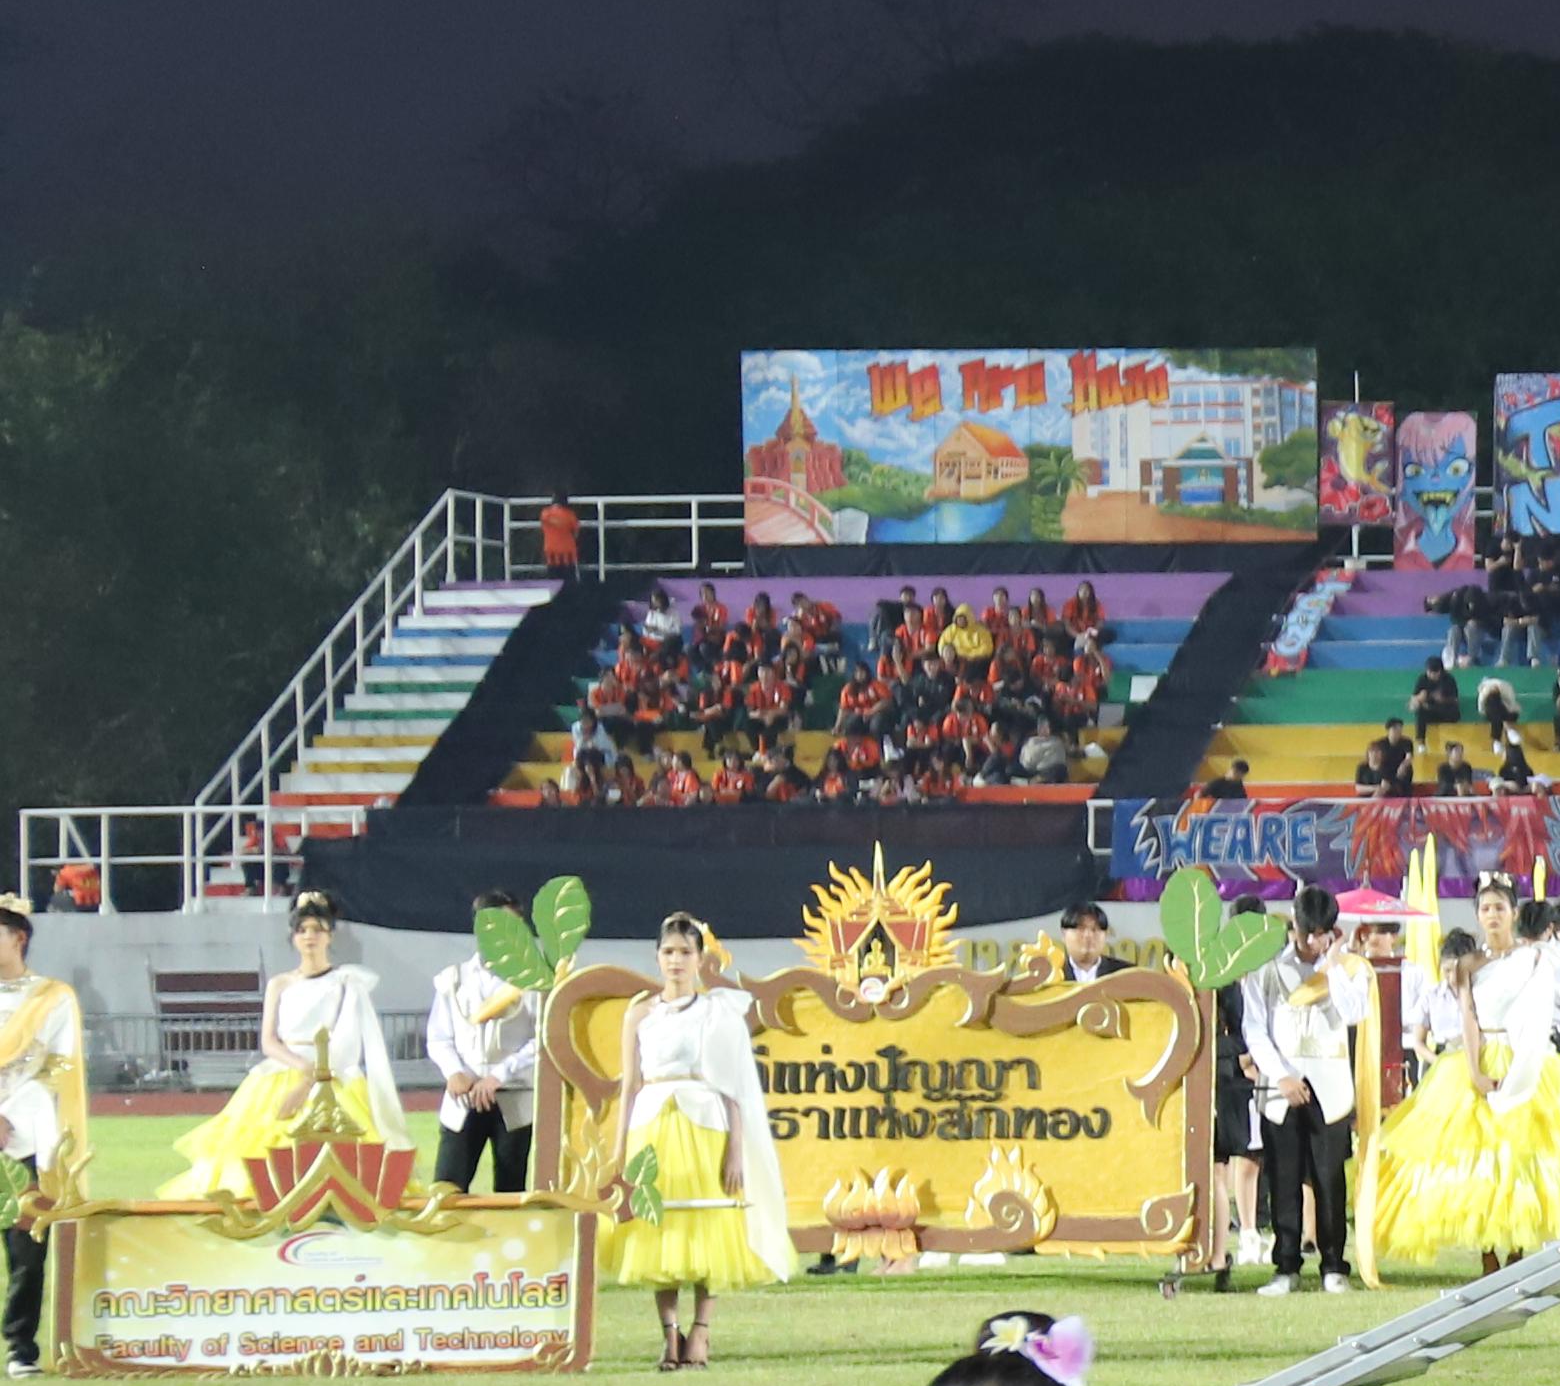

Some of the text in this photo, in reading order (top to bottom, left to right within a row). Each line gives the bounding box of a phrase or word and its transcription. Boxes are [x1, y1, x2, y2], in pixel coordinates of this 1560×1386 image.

[94, 1270, 570, 1319] คณะวิทยาศาสตร์และเทคโนโลยี
[94, 1333, 193, 1362] Faculty
[201, 1332, 231, 1356] of
[238, 1331, 344, 1356] Science
[354, 1328, 405, 1353] and
